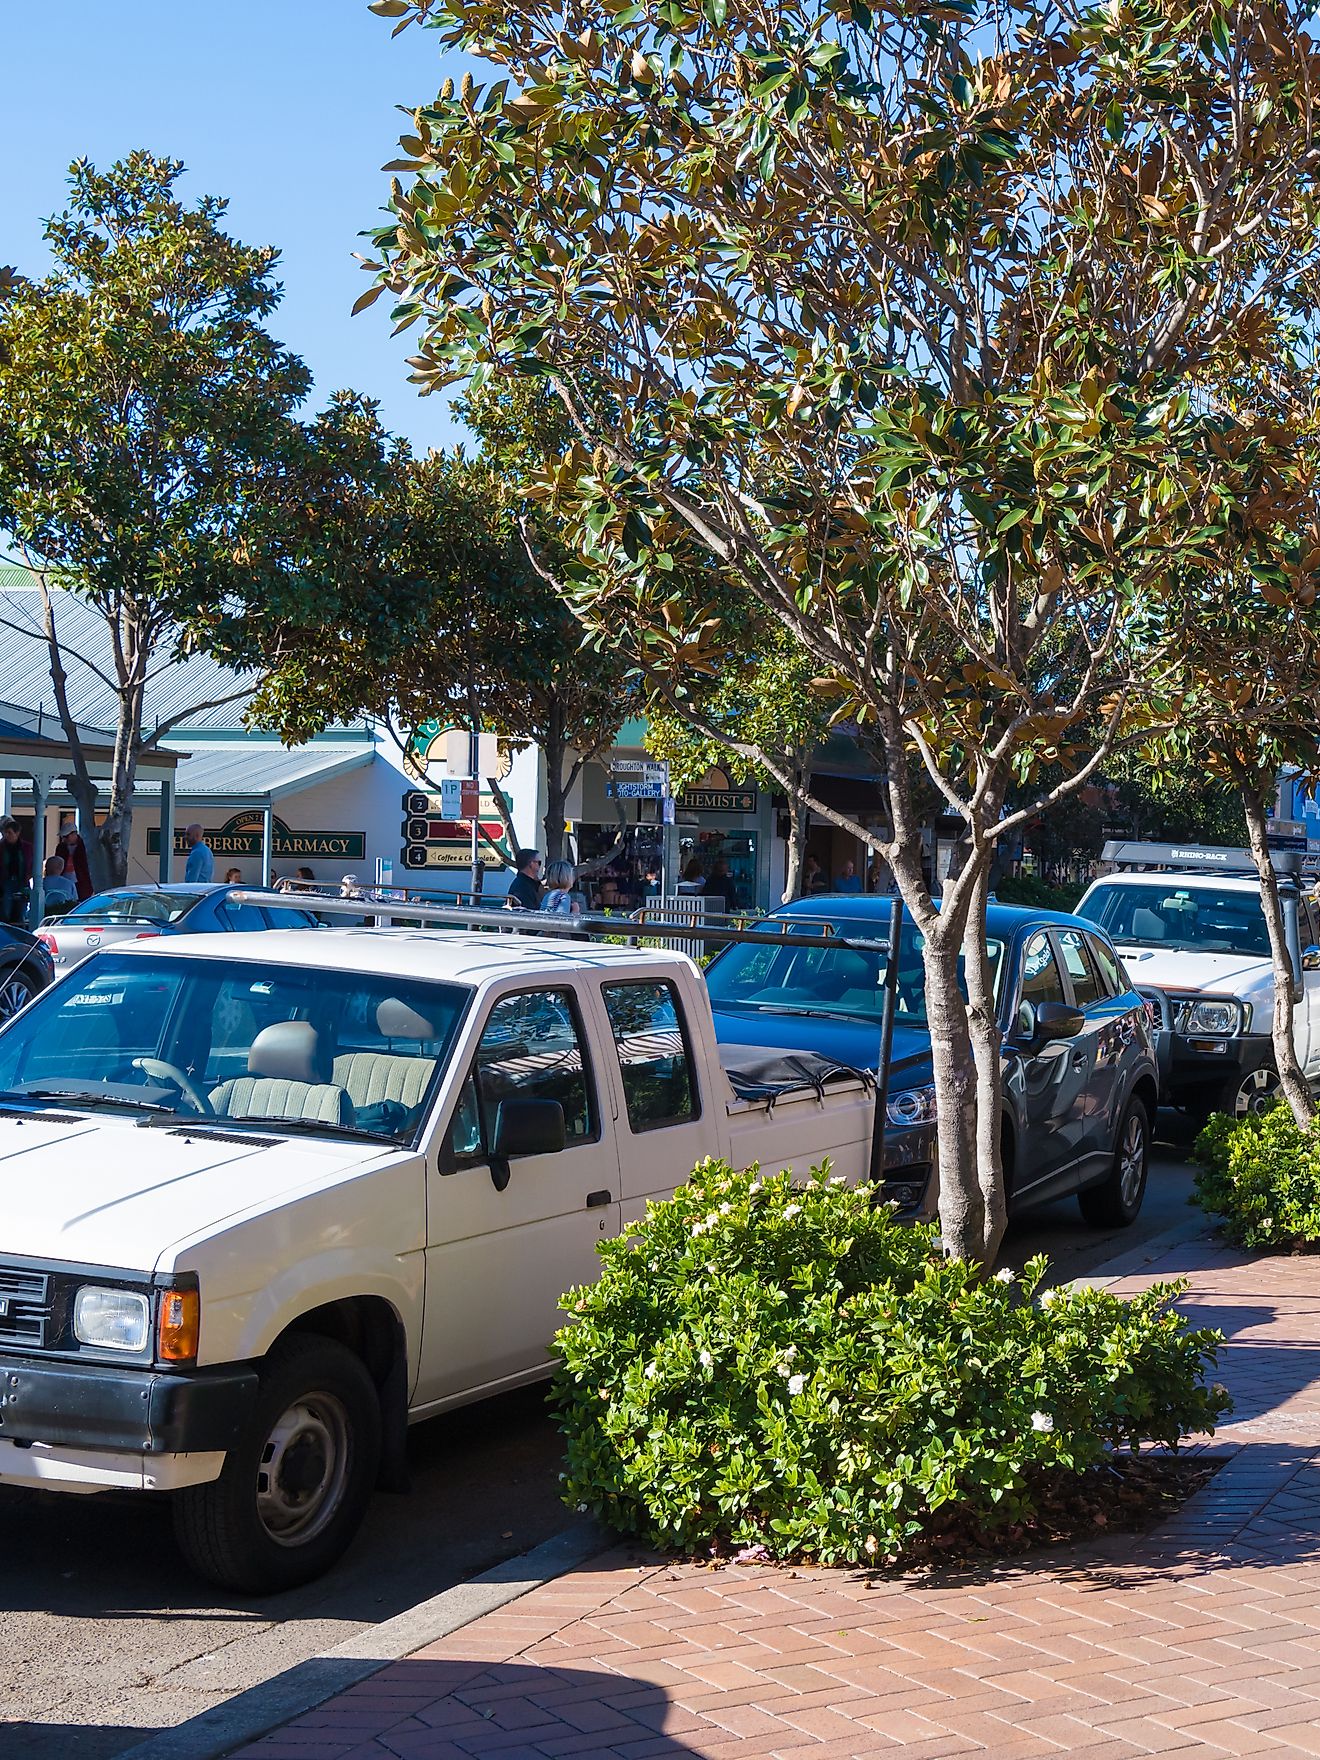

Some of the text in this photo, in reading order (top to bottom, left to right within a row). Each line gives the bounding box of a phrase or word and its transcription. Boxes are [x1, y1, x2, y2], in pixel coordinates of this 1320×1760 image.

[617, 783, 654, 791] IGHTSTORM
[416, 801, 424, 810] 2
[675, 794, 740, 808] CHEMIST
[236, 815, 253, 826] OPEN
[415, 827, 422, 837] 3
[203, 836, 253, 851] BERRY
[260, 837, 350, 853] HARMACY
[414, 852, 422, 862] 4
[437, 854, 458, 862] Coffee
[464, 854, 496, 862] Cholate
[1178, 850, 1228, 861] RHINO-RACK
